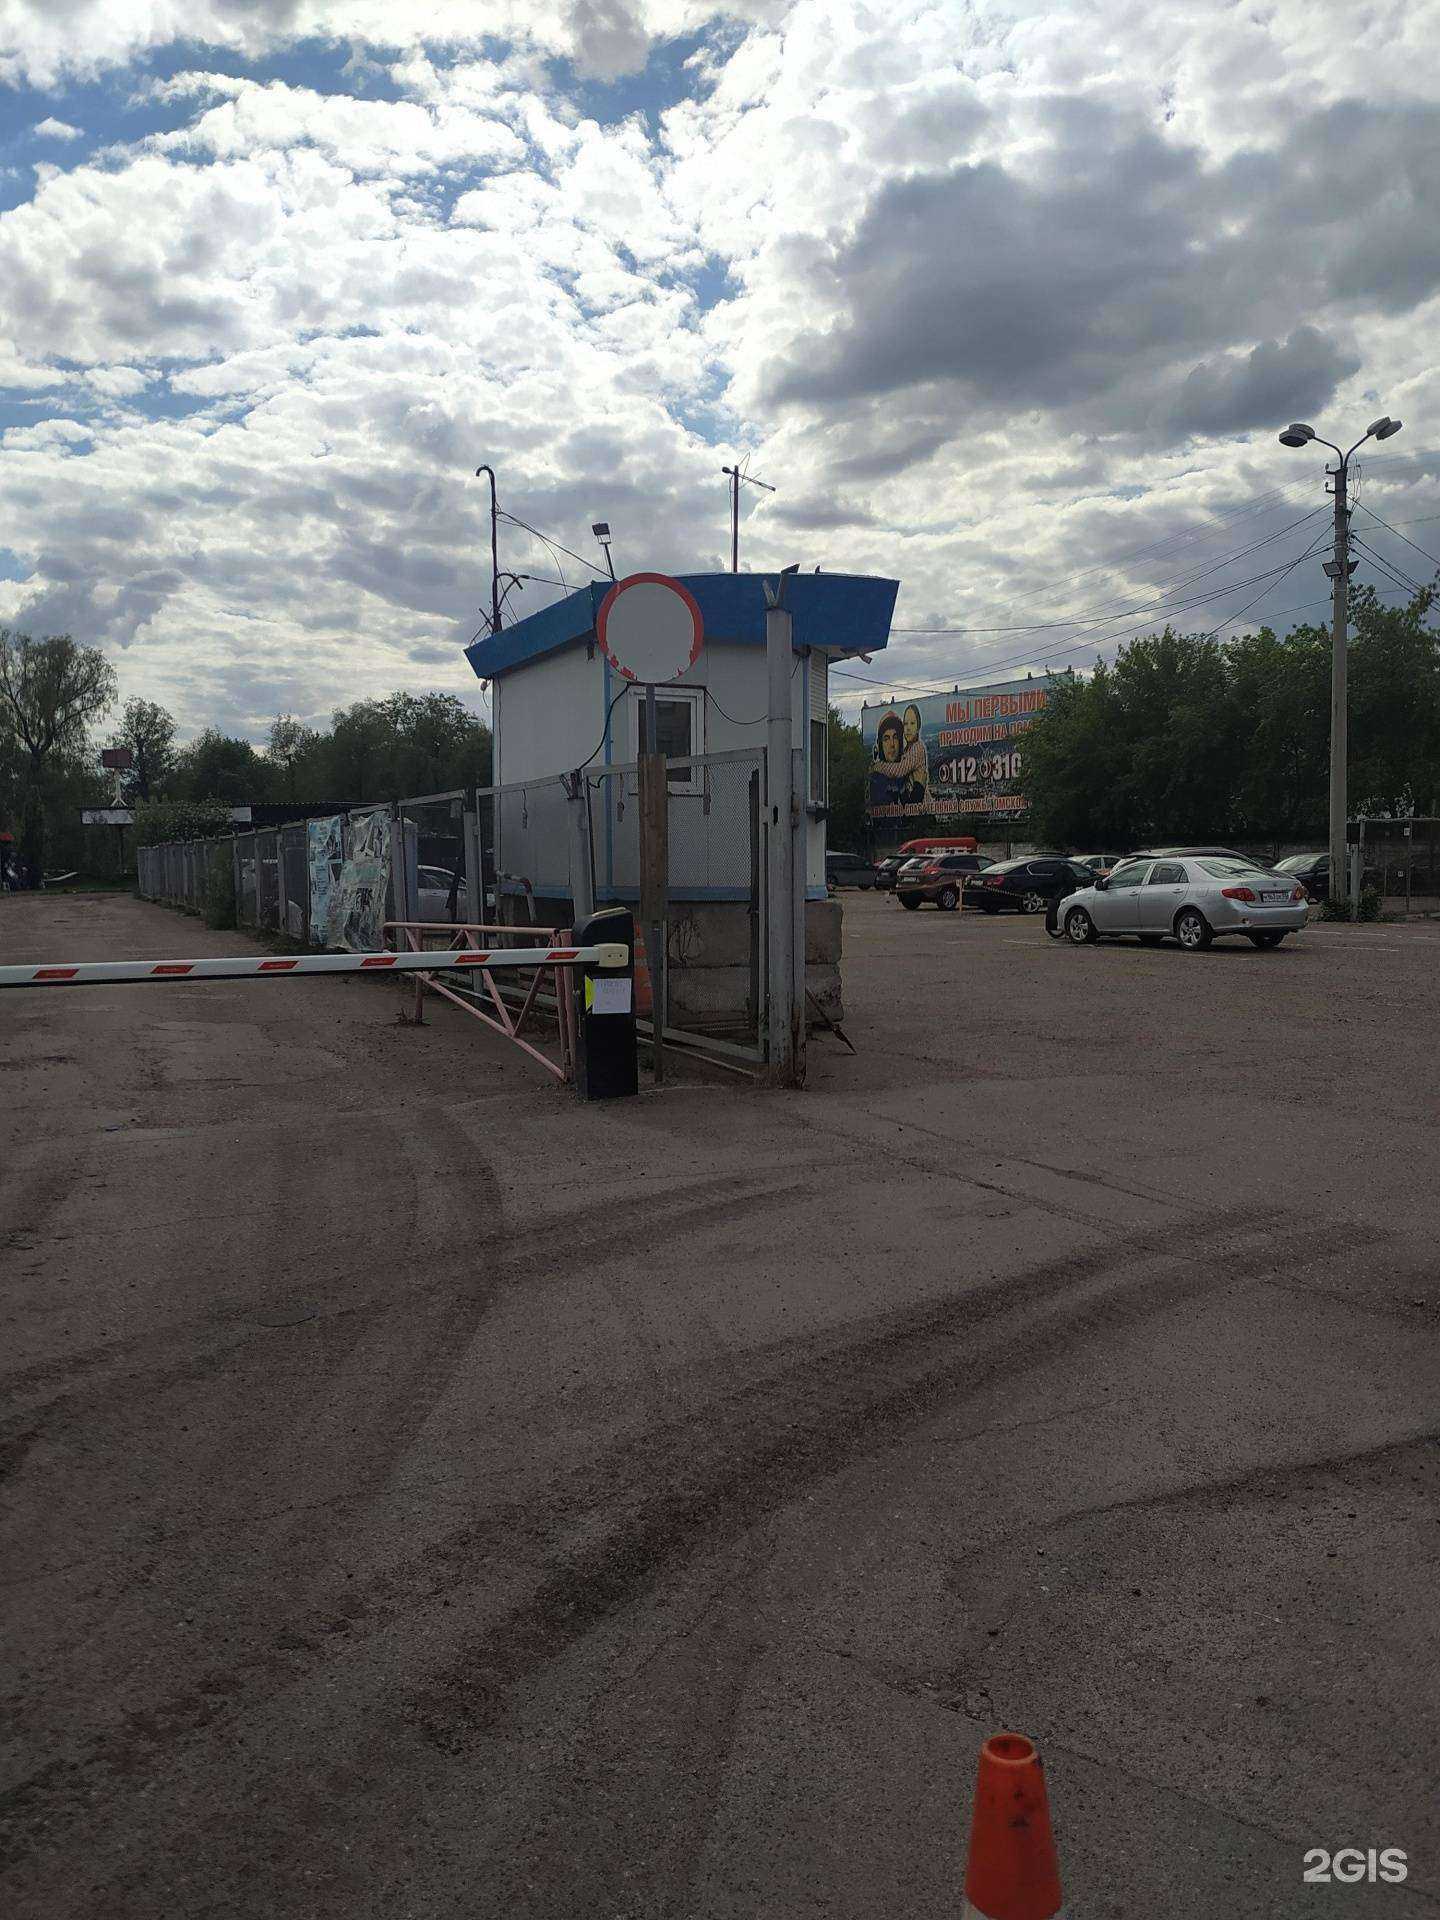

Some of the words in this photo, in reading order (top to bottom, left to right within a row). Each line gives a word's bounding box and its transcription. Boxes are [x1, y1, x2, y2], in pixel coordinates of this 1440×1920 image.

[945, 700, 970, 723] МЫ
[973, 688, 1047, 720] ПЕРВЫМИ
[938, 725, 993, 748] ПРИХОДИМ
[993, 722, 1008, 741] НА
[950, 757, 977, 784] 112
